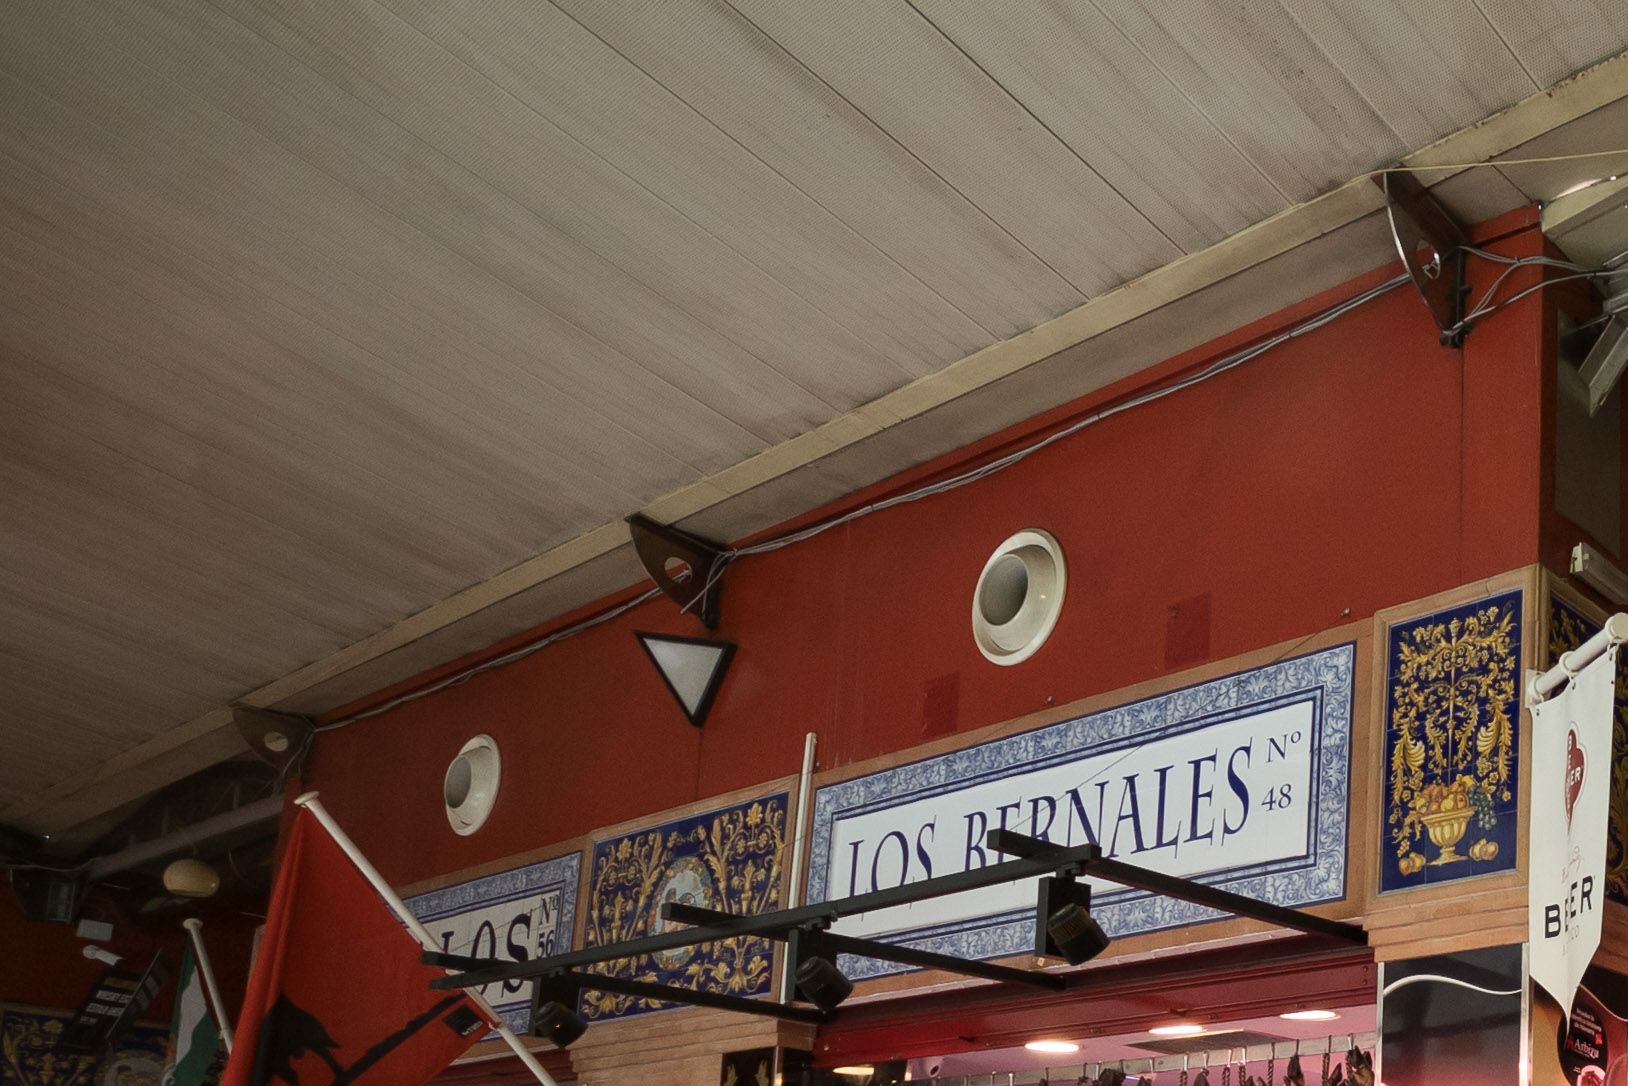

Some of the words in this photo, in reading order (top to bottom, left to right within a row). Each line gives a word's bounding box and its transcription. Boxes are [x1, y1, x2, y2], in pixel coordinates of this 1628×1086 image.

[1265, 730, 1302, 764] Nº
[963, 736, 1254, 872] BERNALES
[1261, 783, 1293, 813] 48
[536, 929, 555, 958] 56
